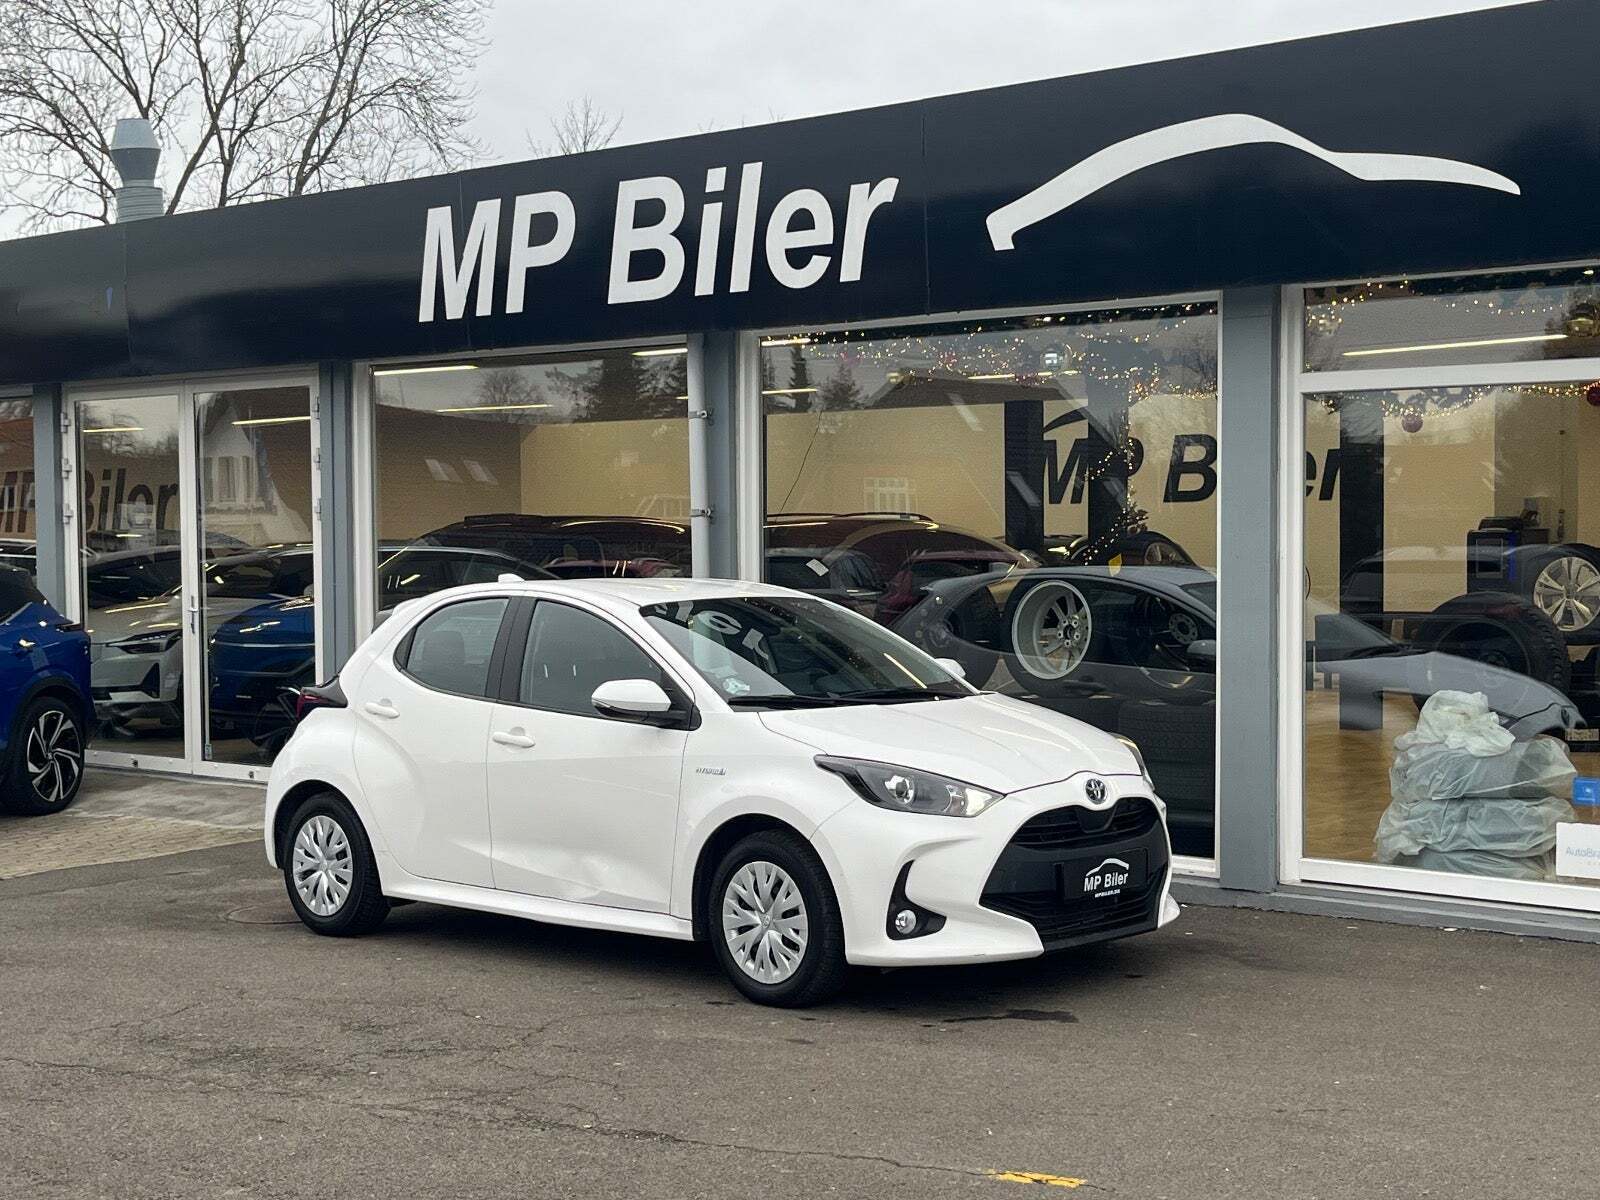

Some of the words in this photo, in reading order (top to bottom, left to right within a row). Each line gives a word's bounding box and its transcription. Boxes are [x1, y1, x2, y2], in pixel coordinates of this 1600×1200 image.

[419, 191, 575, 322] MP
[607, 162, 900, 304] Biler
[1084, 876, 1101, 891] MP
[1104, 872, 1129, 887] Biler
